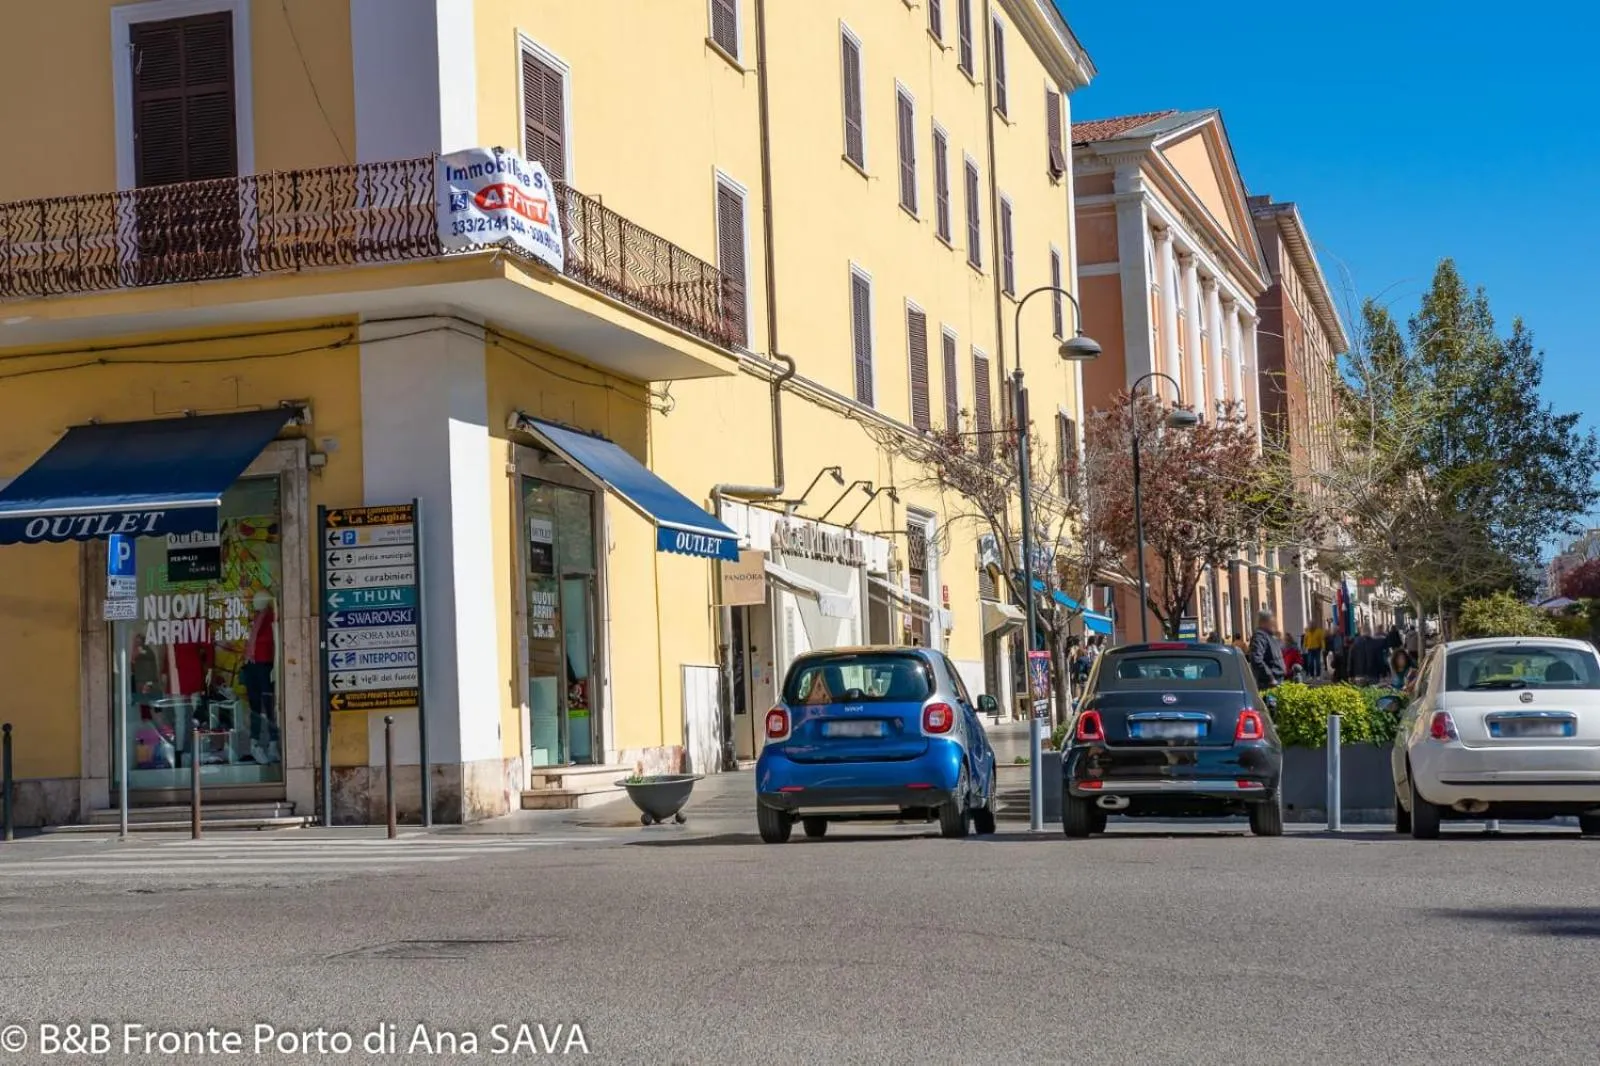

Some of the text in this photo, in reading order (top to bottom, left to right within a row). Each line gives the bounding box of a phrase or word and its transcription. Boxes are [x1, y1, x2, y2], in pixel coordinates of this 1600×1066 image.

[25, 511, 165, 538] OUTLET
[675, 532, 722, 555] OUTLET
[117, 541, 131, 570] P
[364, 572, 412, 582] carabinieri
[725, 573, 763, 581] PANDORA
[352, 589, 401, 602] THUN
[143, 594, 205, 619] NUOVI
[225, 597, 248, 618] 30%
[347, 610, 412, 625] SWAROVSKI
[144, 619, 206, 645] ARRIVI
[225, 620, 249, 640] 50%
[360, 630, 415, 640] SORA MARIA
[360, 651, 416, 665] INTERPORTO
